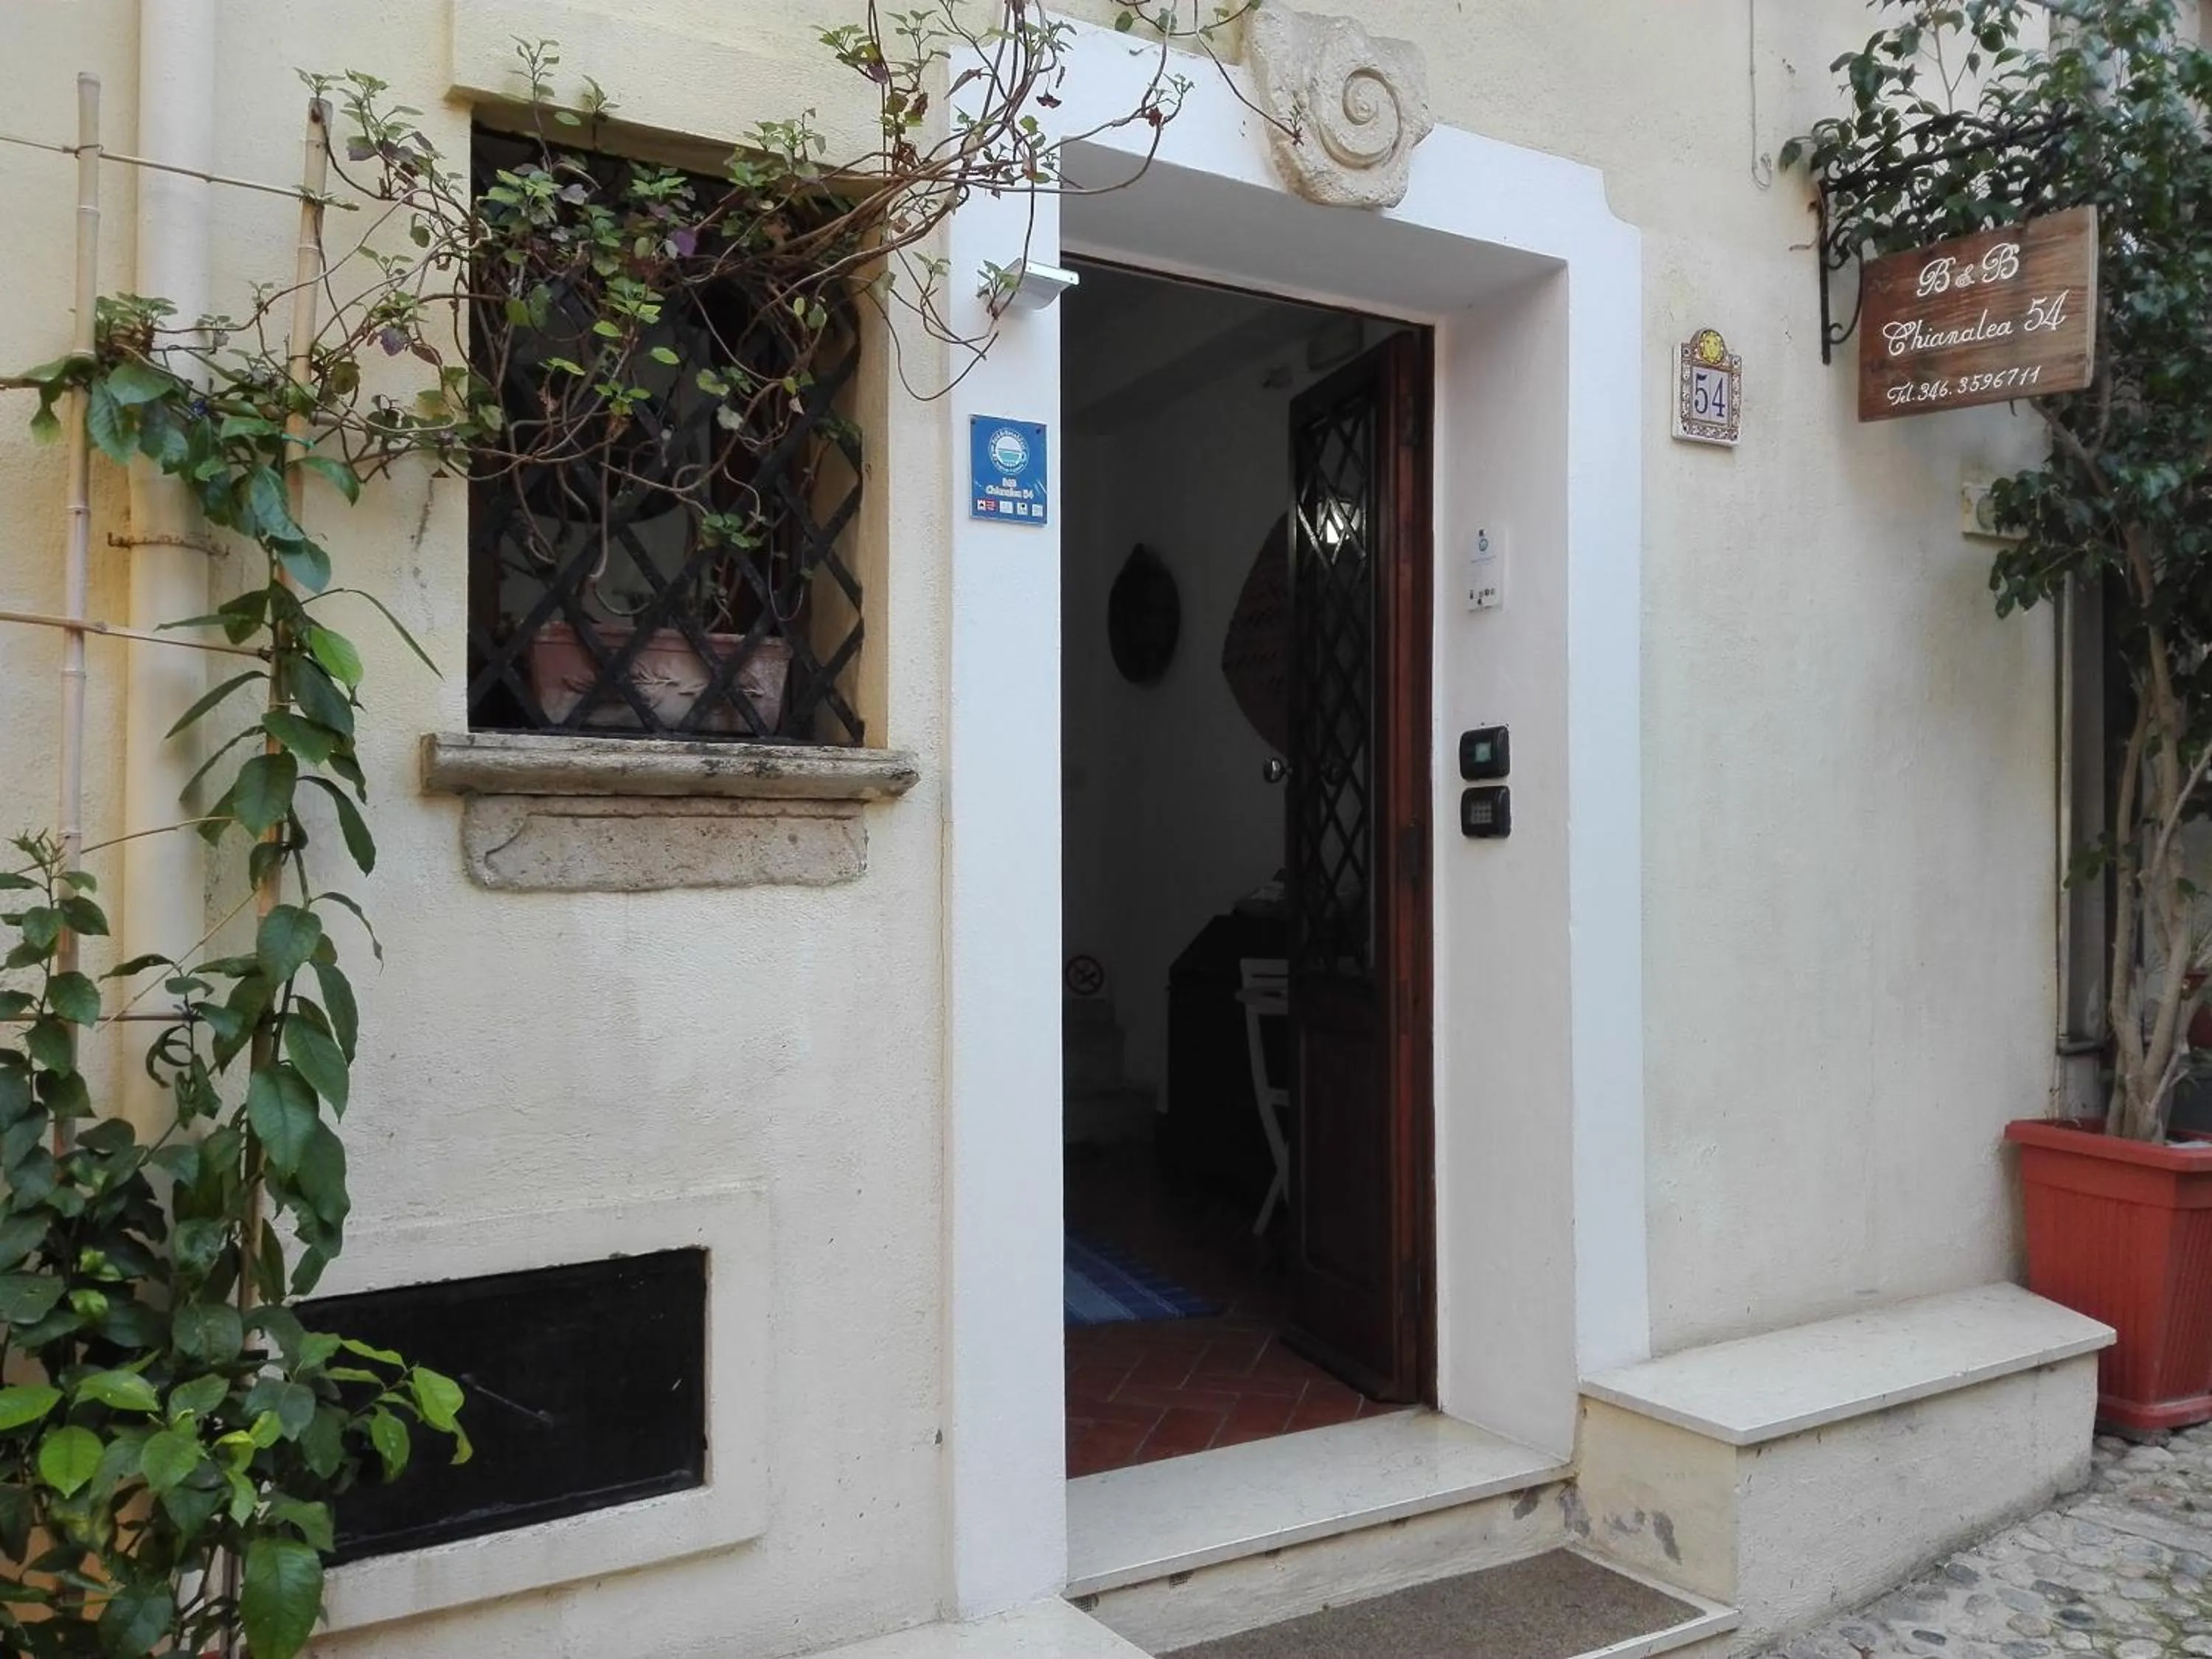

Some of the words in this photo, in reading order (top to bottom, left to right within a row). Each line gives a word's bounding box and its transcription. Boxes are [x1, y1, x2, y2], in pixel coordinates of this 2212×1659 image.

[1882, 310, 2014, 356] Chianalea
[2024, 289, 2070, 330] 54
[1694, 372, 1726, 417] 54
